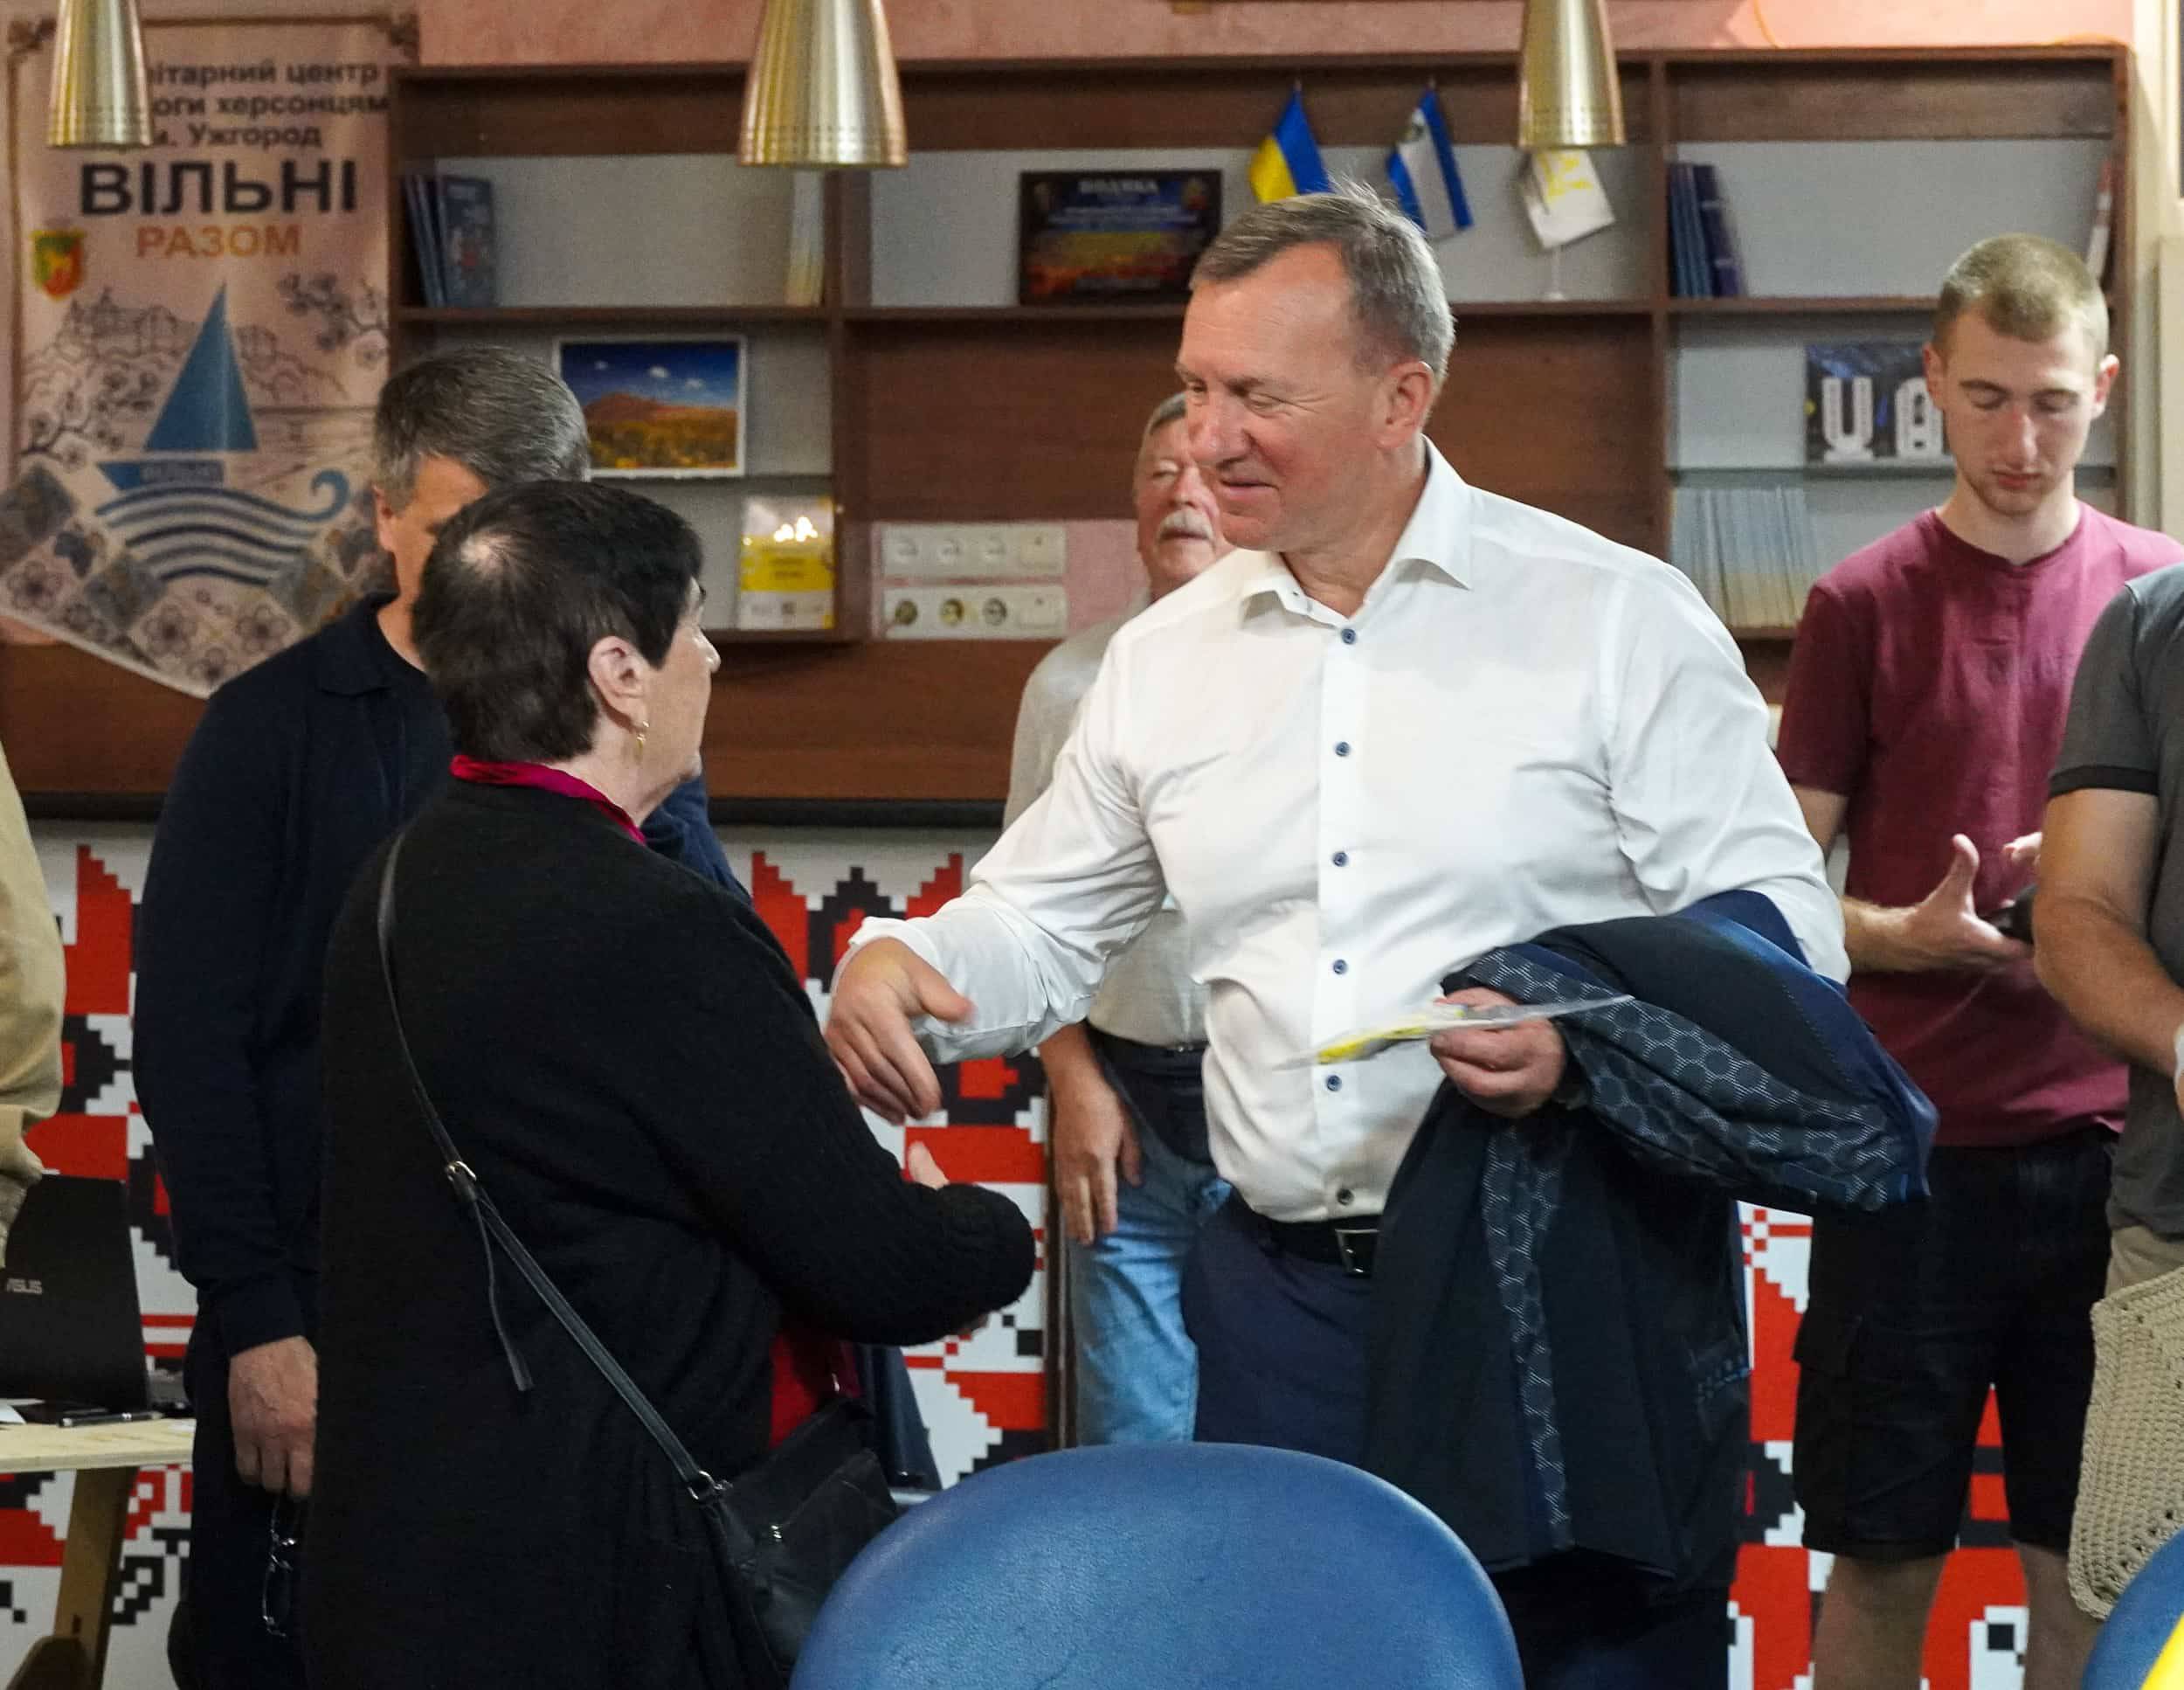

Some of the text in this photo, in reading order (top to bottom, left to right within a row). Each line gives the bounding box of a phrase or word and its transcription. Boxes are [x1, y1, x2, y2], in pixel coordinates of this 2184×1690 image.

[287, 64, 377, 87] центр
[152, 95, 389, 118] оги херсонцям
[188, 122, 322, 149] Ужгород
[80, 159, 357, 215] ВІЛЬНІ
[135, 224, 302, 260] РАЗОМ
